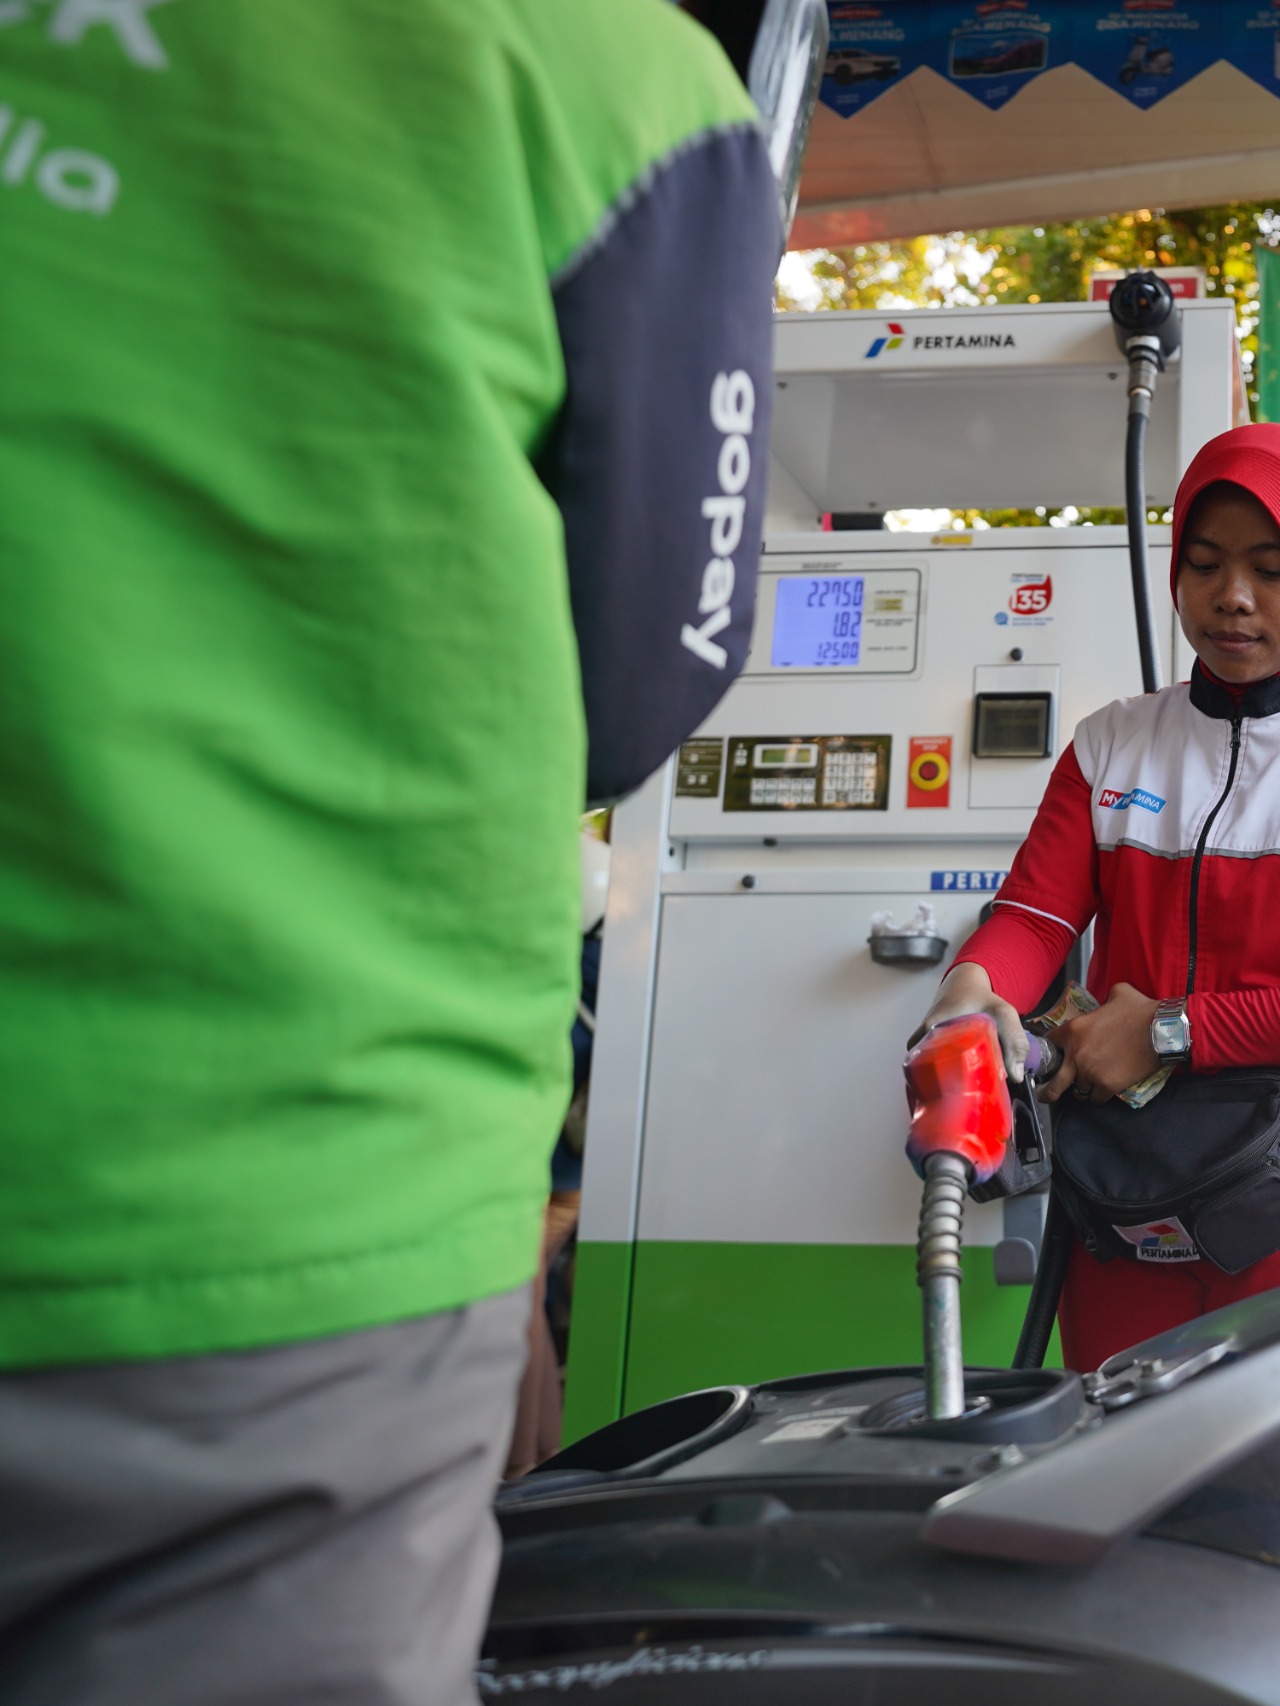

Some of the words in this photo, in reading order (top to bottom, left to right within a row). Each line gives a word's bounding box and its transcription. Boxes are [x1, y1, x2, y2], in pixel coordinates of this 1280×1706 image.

[914, 334, 1016, 350] PERTAMINA
[681, 369, 755, 669] gopay
[807, 581, 865, 608] 22750
[1012, 589, 1048, 611] 135
[817, 642, 861, 660] 12500
